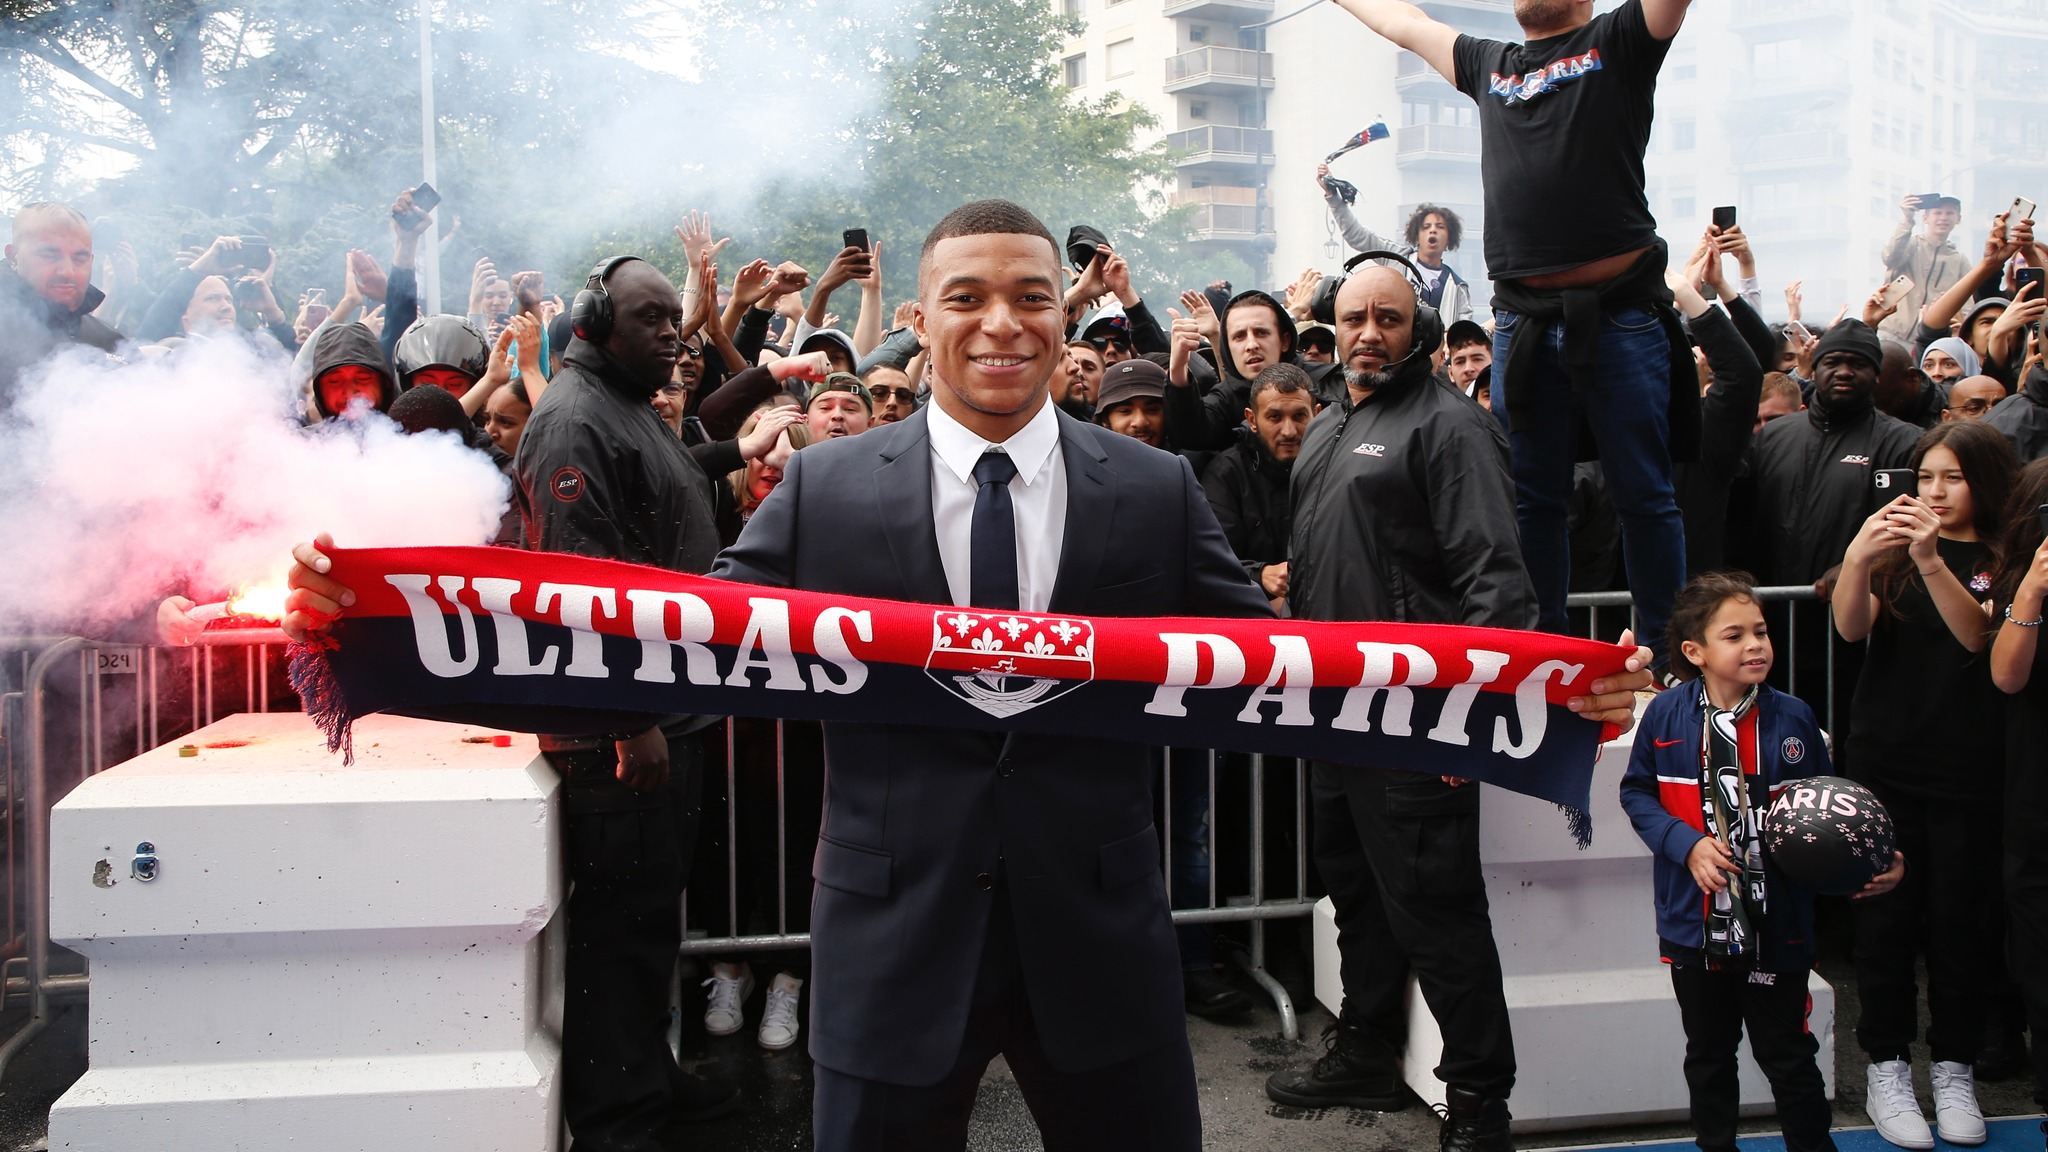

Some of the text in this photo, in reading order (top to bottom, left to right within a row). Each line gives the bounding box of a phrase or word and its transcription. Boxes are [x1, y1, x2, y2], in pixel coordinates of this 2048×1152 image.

[1354, 442, 1386, 455] ESP
[558, 478, 578, 490] ESP
[384, 574, 1585, 759] ULTRAS PARIS
[1748, 971, 1776, 985] NIKE
